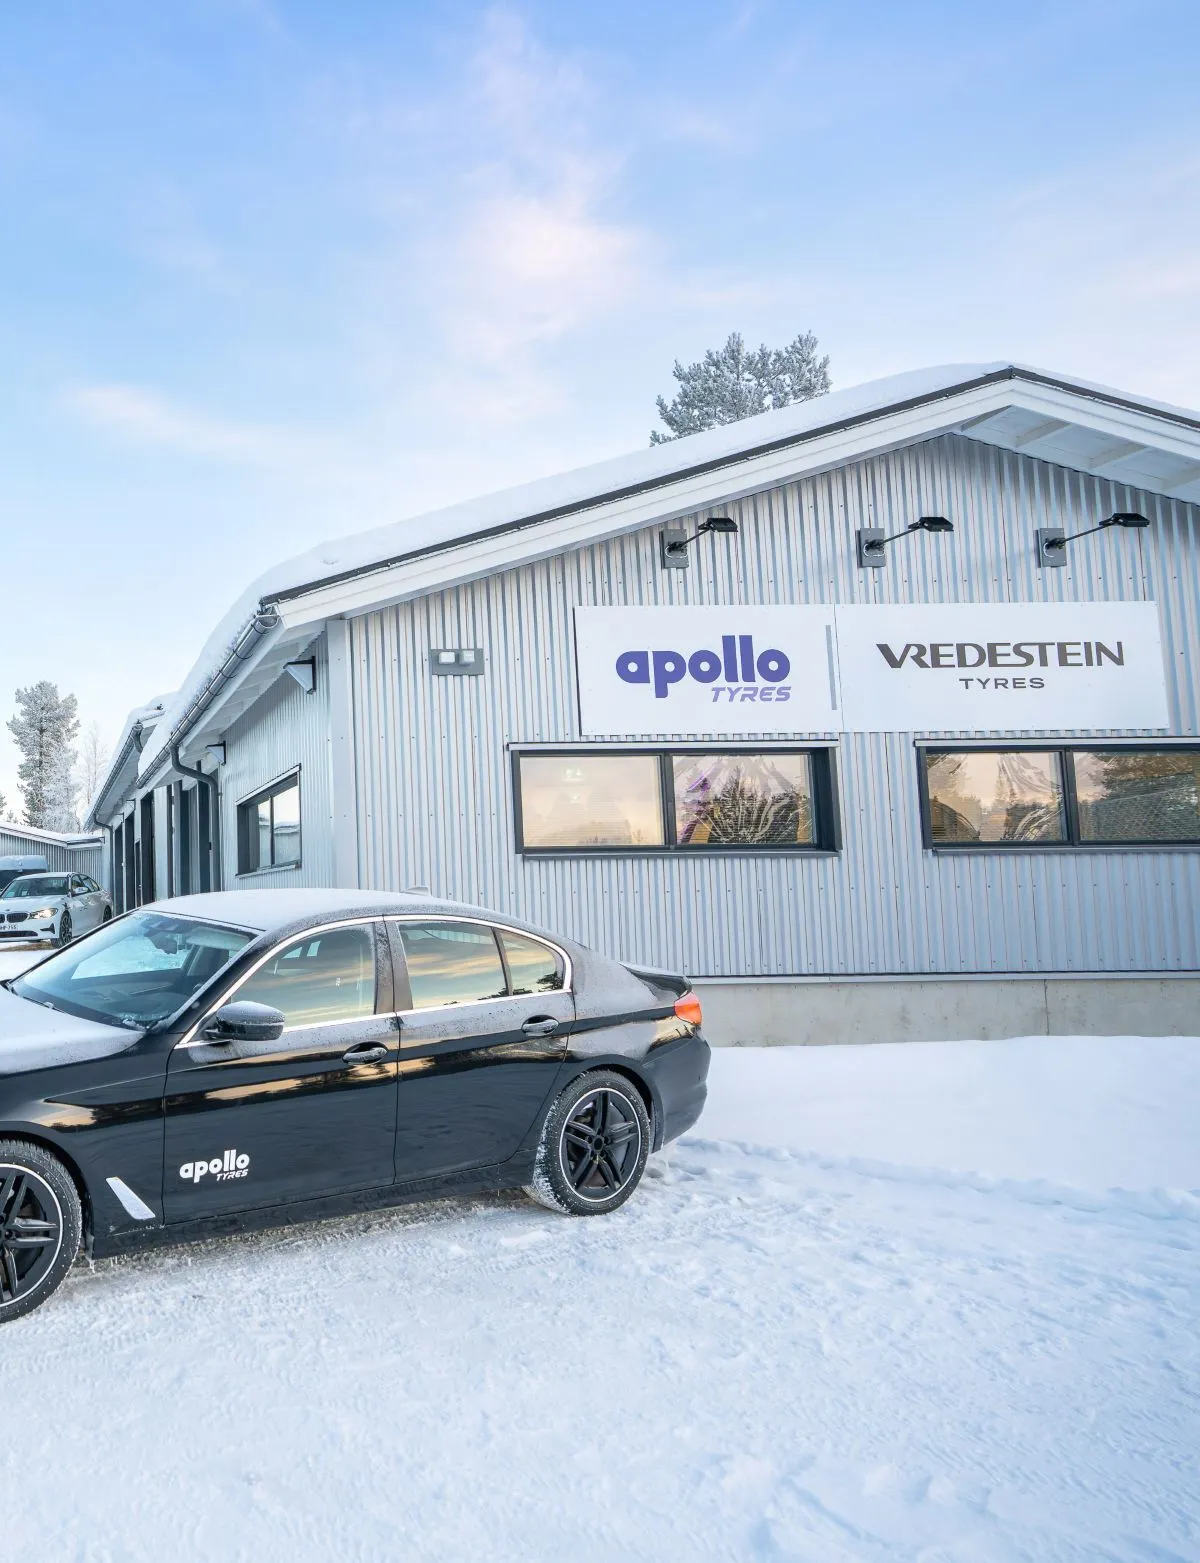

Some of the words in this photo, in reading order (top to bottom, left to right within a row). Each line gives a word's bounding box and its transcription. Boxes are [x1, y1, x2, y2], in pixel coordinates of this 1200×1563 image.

[876, 641, 1125, 668] VREDESTEIN
[616, 635, 790, 698] apollo
[959, 677, 1045, 689] TYRES
[711, 686, 792, 702] TYRES
[179, 1149, 250, 1183] apollo
[216, 1169, 248, 1181] TYRES
